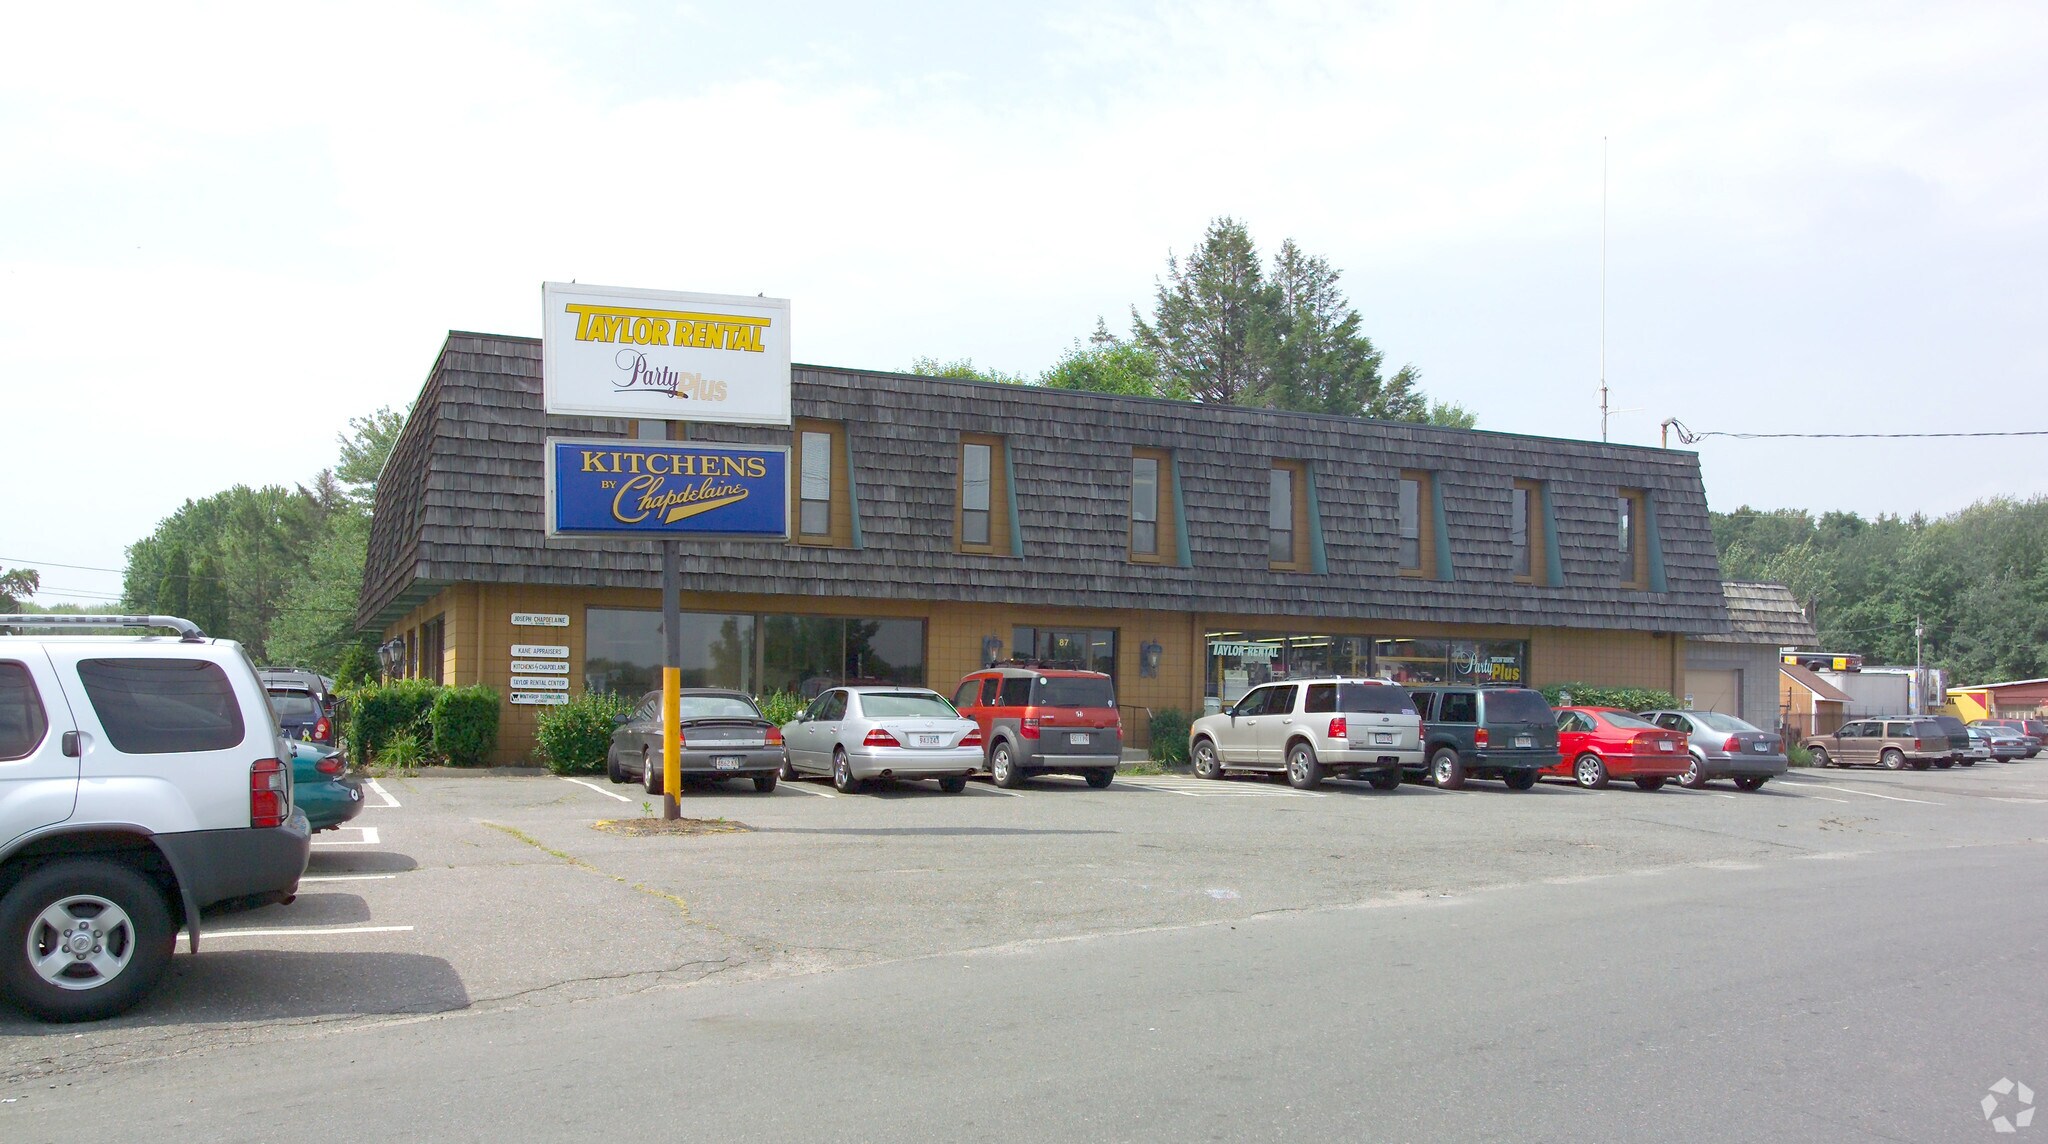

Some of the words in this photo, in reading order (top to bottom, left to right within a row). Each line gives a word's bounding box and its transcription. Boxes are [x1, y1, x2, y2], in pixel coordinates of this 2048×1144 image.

[565, 303, 671, 346] TAYLOR
[674, 318, 766, 353] RENTAL
[611, 348, 682, 398] Party
[679, 371, 728, 401] Plus
[580, 451, 767, 478] KITCHENS
[601, 480, 618, 489] BY
[610, 474, 749, 525] Chapdelaine
[1058, 638, 1069, 647] 87
[1207, 640, 1245, 656] TAYLOR
[1247, 646, 1279, 658] RENTAL
[1456, 650, 1492, 680] Party
[1491, 663, 1520, 681] Plus
